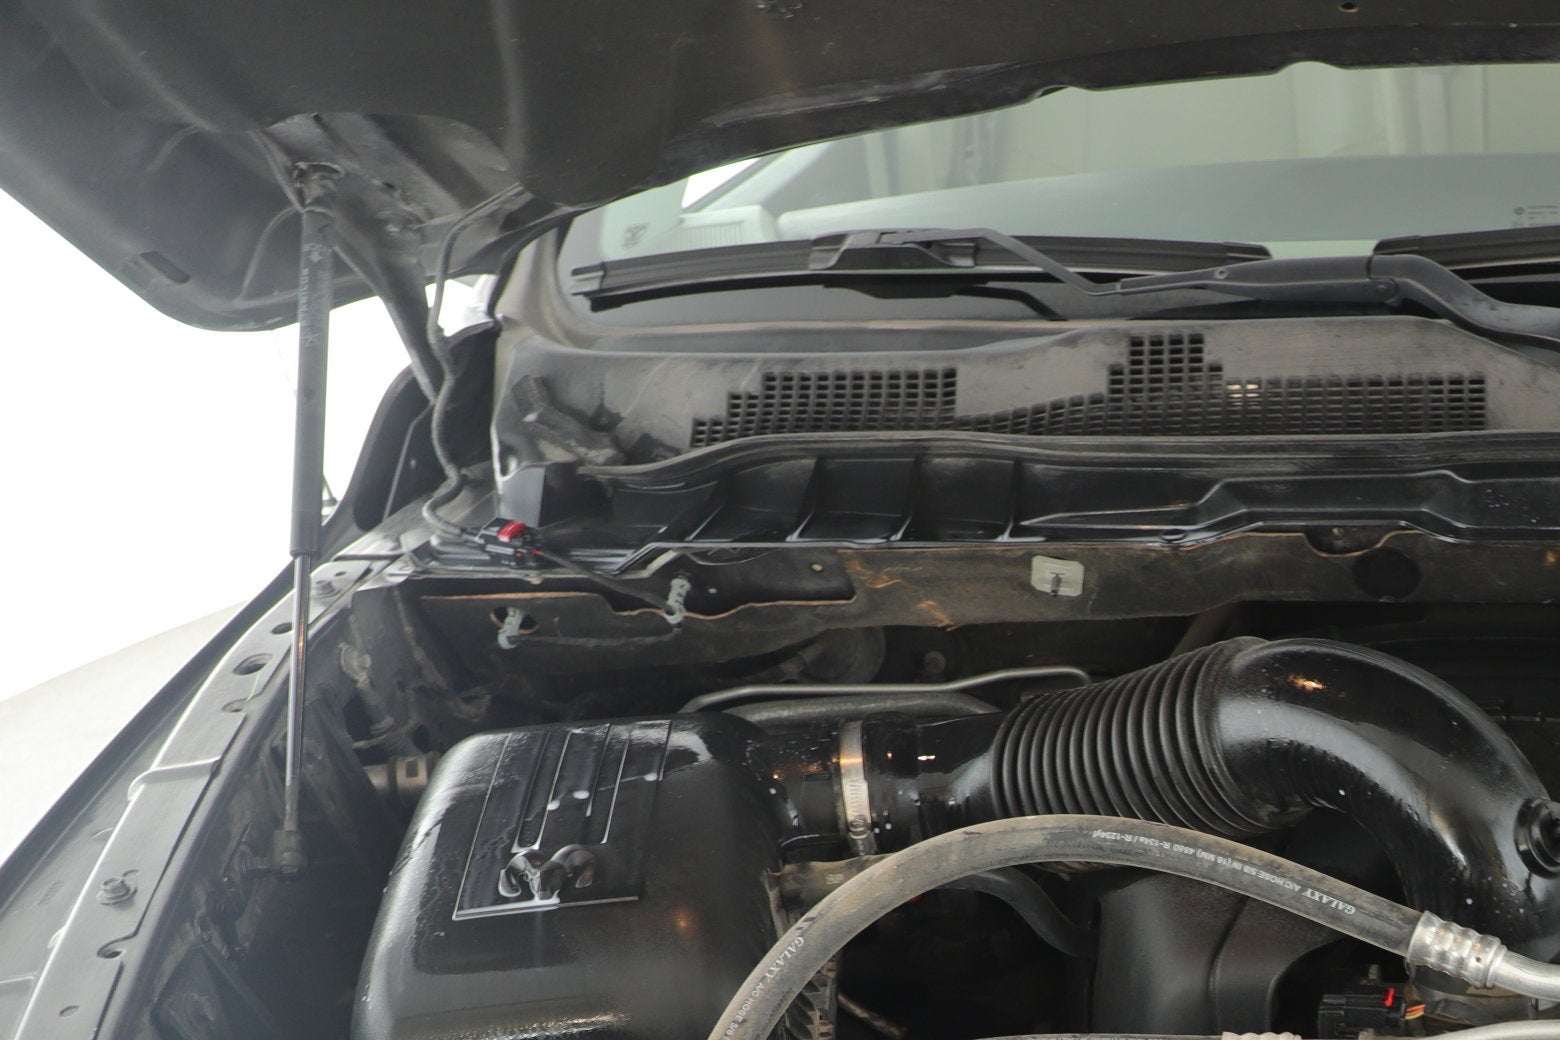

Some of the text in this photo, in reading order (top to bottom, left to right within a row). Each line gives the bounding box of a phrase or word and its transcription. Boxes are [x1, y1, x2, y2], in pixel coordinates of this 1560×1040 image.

[1139, 835, 1171, 850] R-134a
[1258, 870, 1285, 887] HOSE
[1301, 887, 1357, 915] GALAXY
[764, 936, 805, 982] GALAXY
[734, 997, 755, 1023] HOSE
